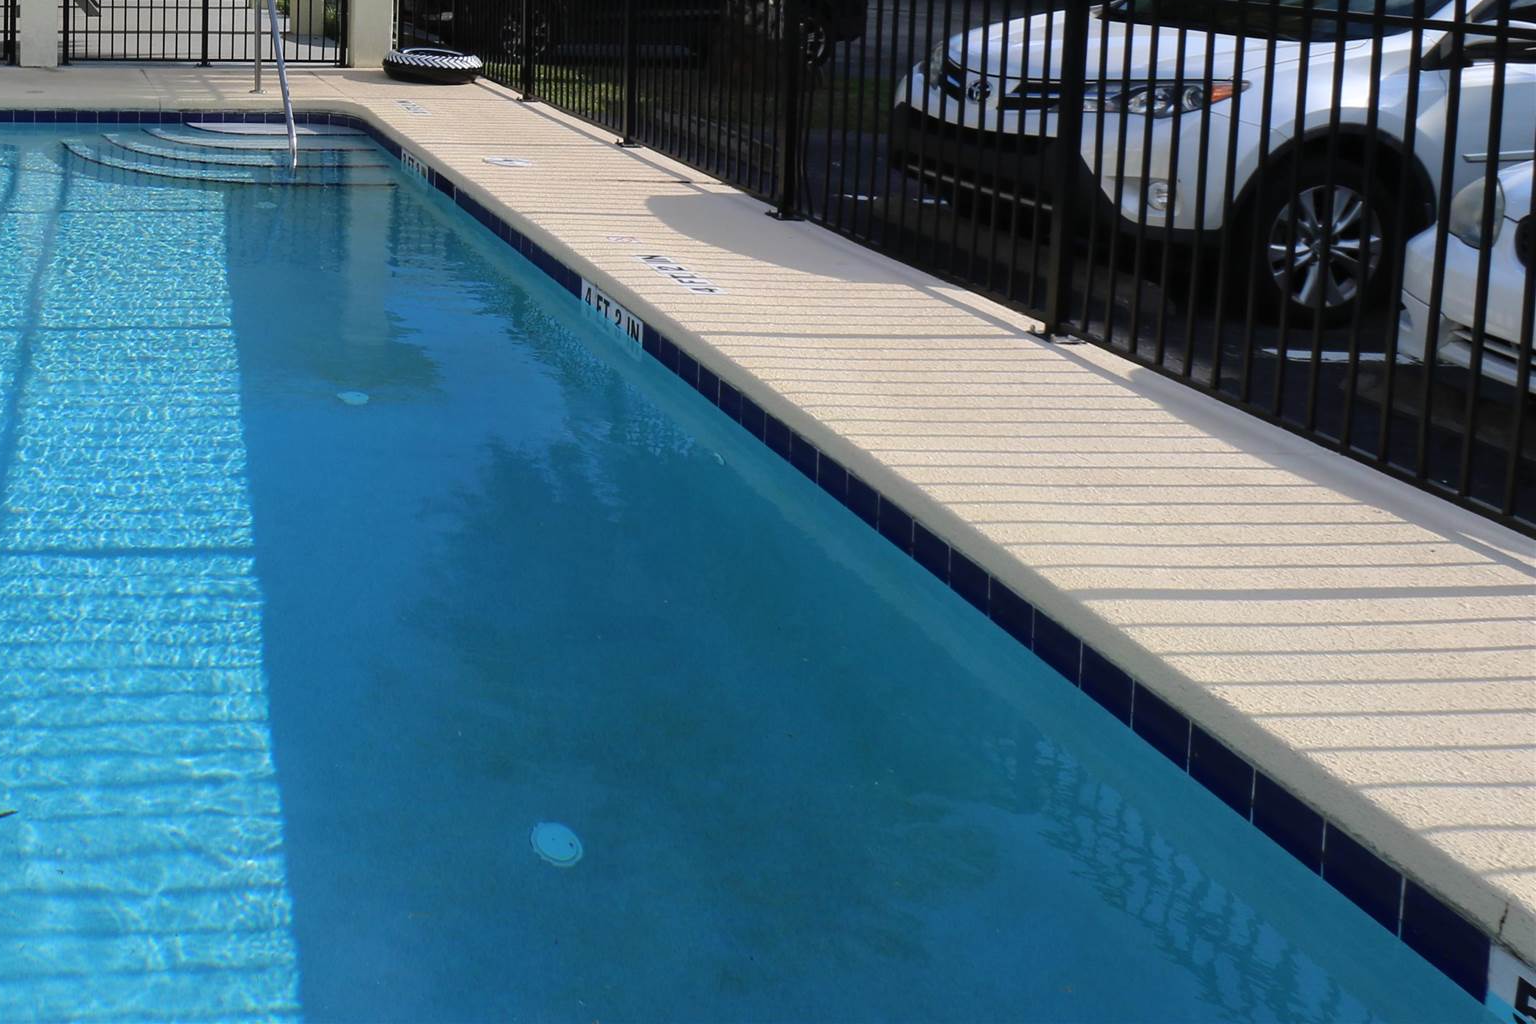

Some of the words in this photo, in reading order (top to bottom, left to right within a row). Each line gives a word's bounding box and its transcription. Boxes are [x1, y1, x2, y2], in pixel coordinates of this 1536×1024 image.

[584, 287, 592, 306] 4
[596, 294, 610, 318] FT
[615, 309, 622, 329] 2
[626, 316, 640, 343] IN
